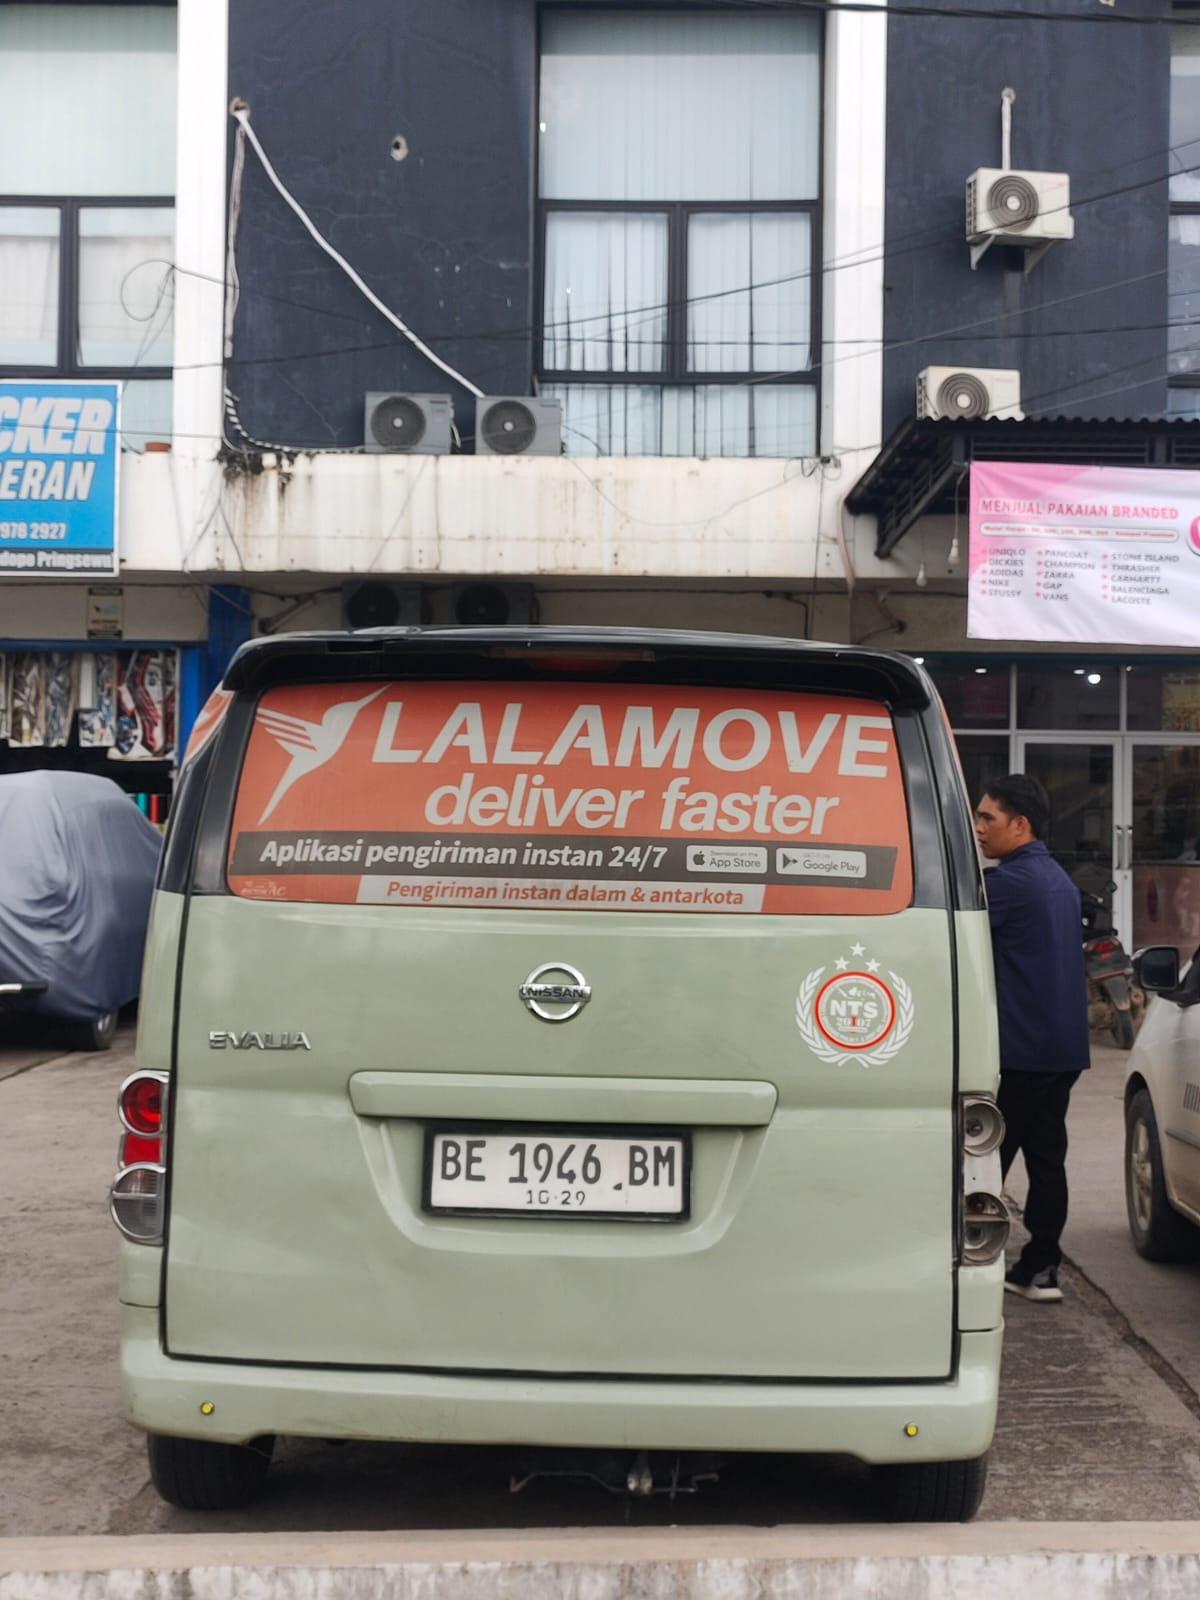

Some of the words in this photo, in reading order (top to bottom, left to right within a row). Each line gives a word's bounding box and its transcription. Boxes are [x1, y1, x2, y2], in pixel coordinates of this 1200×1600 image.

[0, 459, 96, 501] ERAN
[981, 500, 1042, 515] MENJUAL
[1047, 503, 1108, 517] PAKAIAN
[1112, 505, 1179, 520] BRANDED
[30, 521, 67, 540] 2927
[989, 548, 1026, 557] UNIQLO
[1111, 553, 1142, 561] STONE
[989, 558, 1024, 567] DICKIES
[1043, 560, 1095, 570] CHAMPION
[989, 569, 1024, 577] ADIDAS
[988, 579, 1009, 587] NIKE
[1043, 582, 1062, 590] GAP
[988, 590, 1021, 598] STUSSY
[1042, 593, 1069, 601] VANS
[371, 701, 892, 778] LALAMOVE
[424, 772, 645, 829] deliver
[660, 777, 840, 835] faster
[259, 838, 364, 867] Aplikasi
[364, 839, 518, 869] pengiriman
[522, 842, 604, 867] instan
[607, 845, 668, 872] 24/7
[709, 857, 731, 868] App
[733, 857, 761, 868] Store
[802, 859, 839, 873] Google
[840, 861, 860, 873] Play
[386, 880, 497, 901] Pengiriman
[502, 883, 561, 901] instan
[566, 884, 626, 902] dalam
[630, 886, 645, 903] &
[650, 888, 744, 906] antarkota
[527, 986, 584, 998] NISSAN
[829, 999, 878, 1019] NTS
[209, 1031, 312, 1051] EVALIA
[440, 1139, 487, 1182] BE
[508, 1142, 602, 1185] 1946
[628, 1144, 676, 1188] BM
